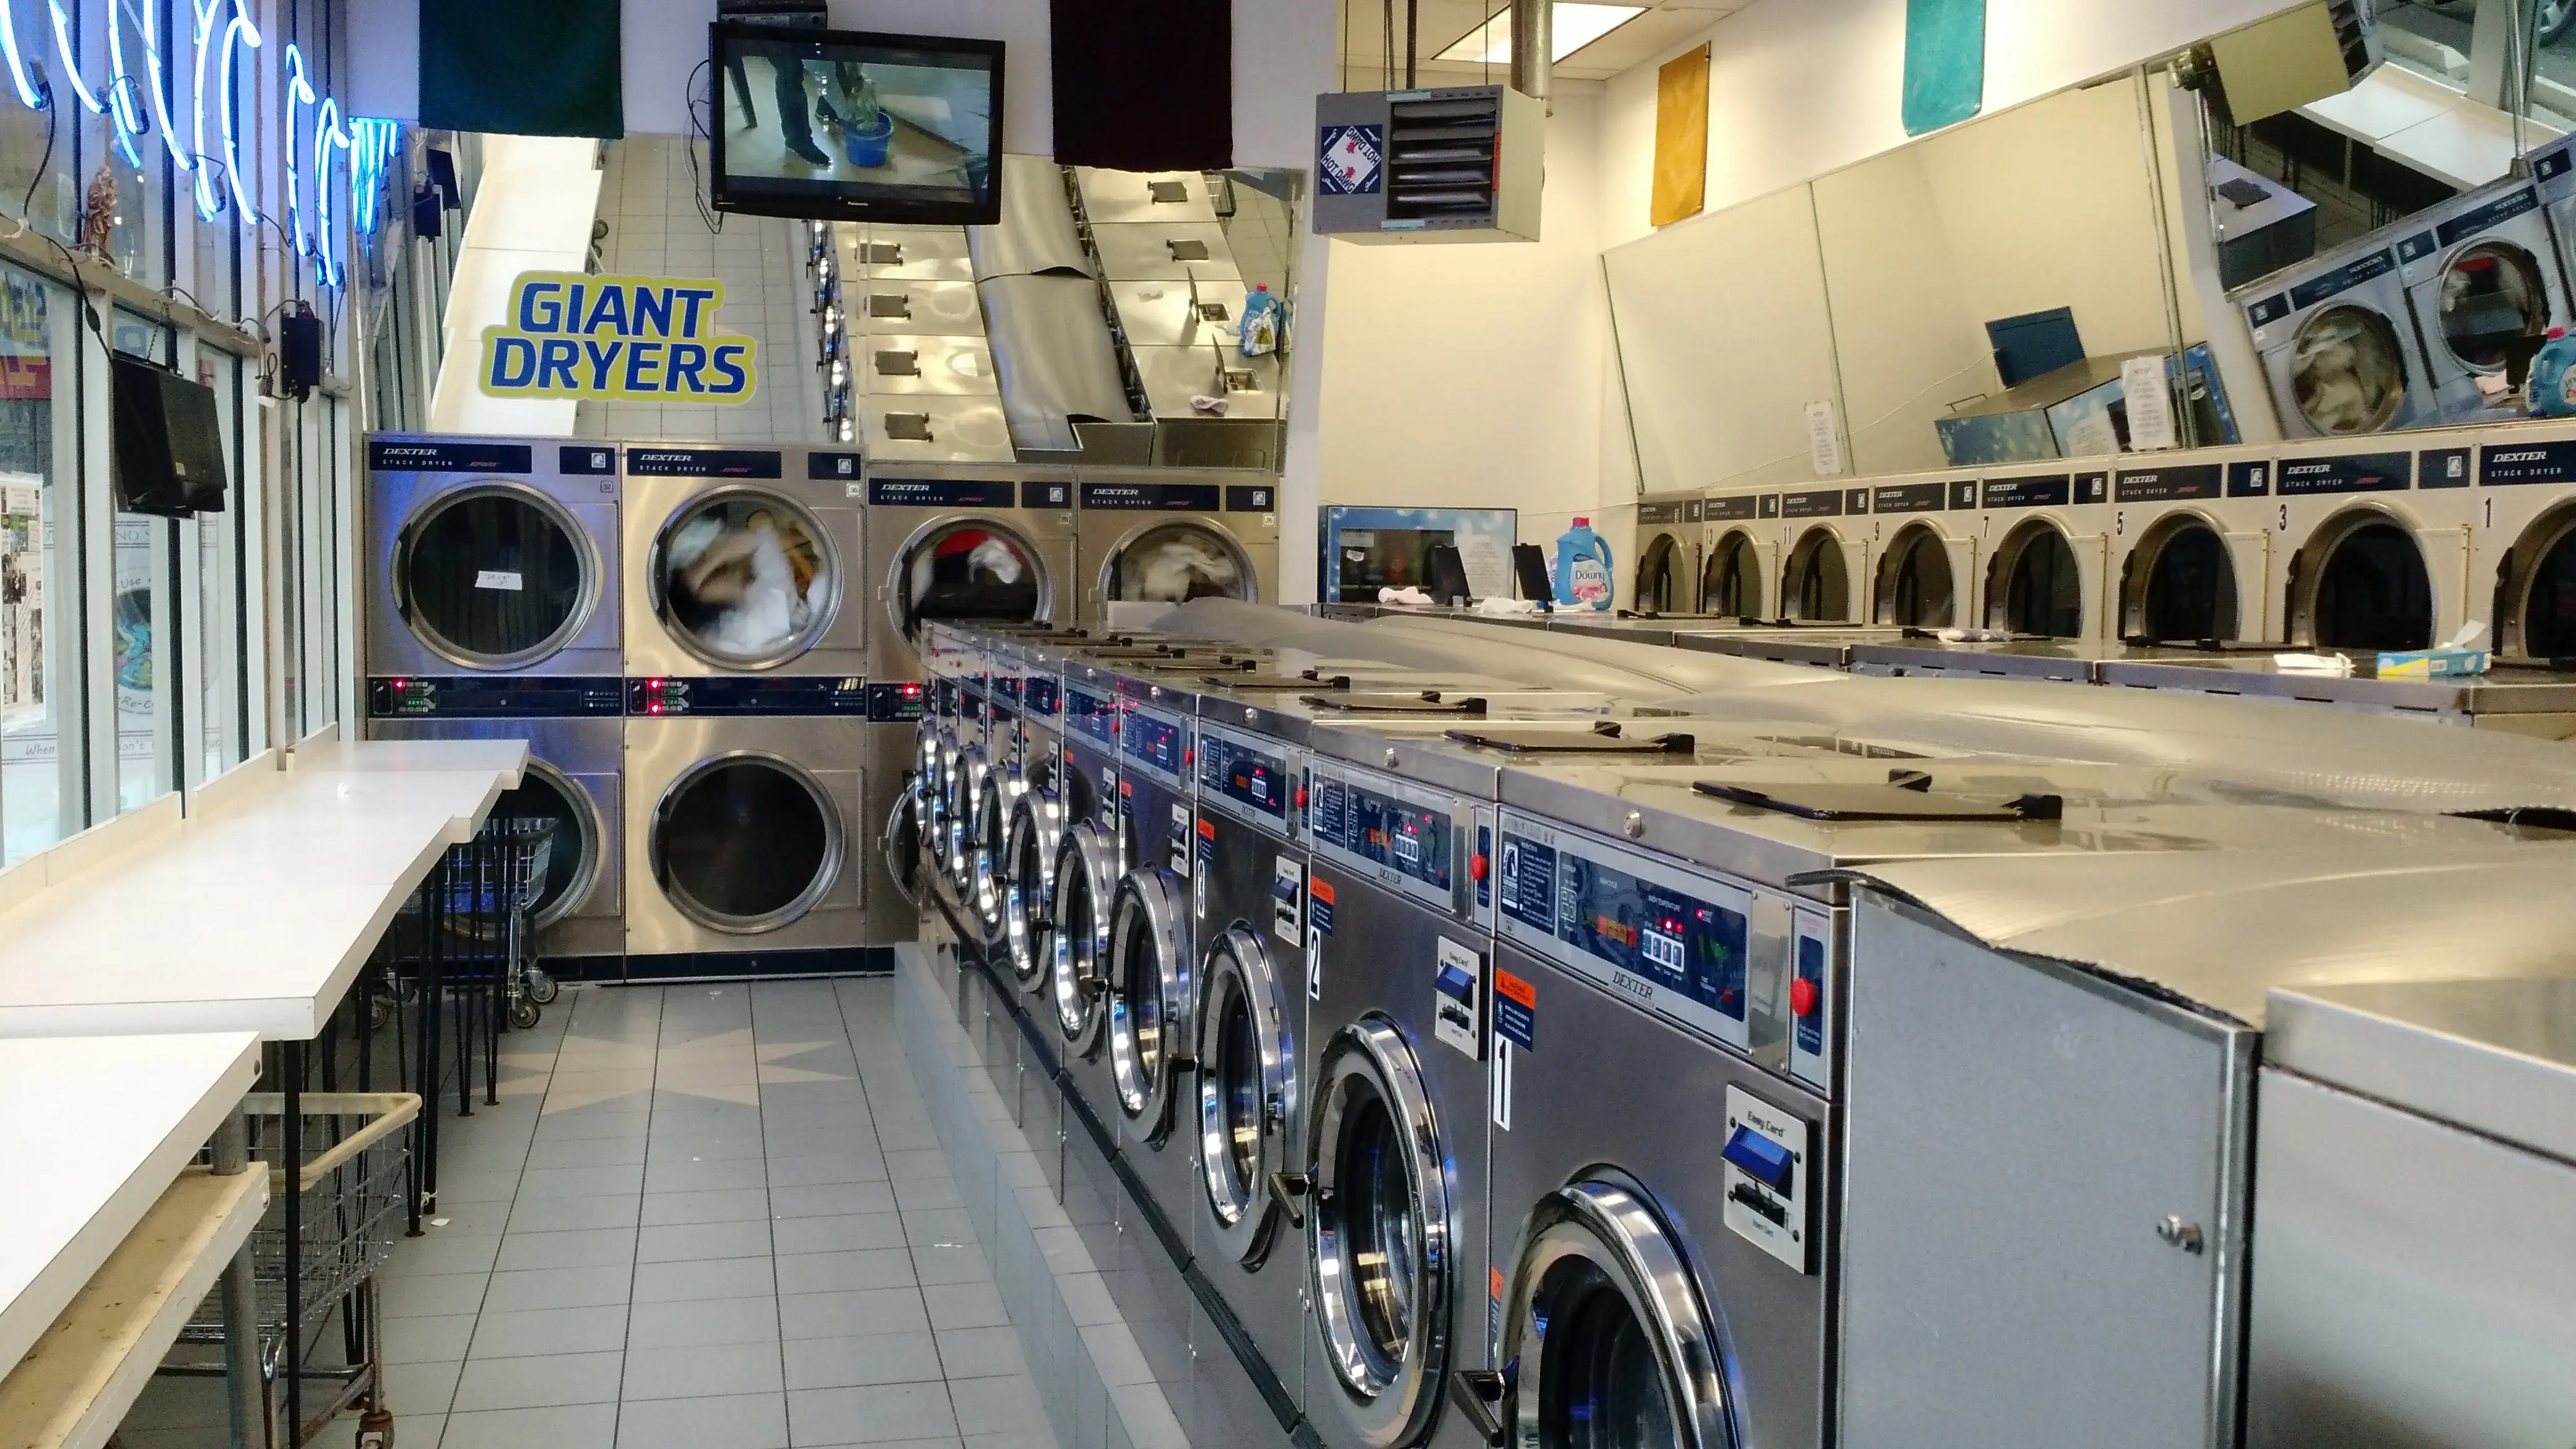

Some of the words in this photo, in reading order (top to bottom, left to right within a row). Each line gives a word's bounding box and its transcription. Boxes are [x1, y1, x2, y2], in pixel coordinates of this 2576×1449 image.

[1346, 128, 1367, 151] DAWG
[1363, 147, 1380, 166] HOT
[1321, 154, 1339, 173] HOT
[1335, 170, 1355, 192] DAWG
[520, 282, 714, 339] GIANT
[490, 337, 746, 394] DRYERS
[2492, 451, 2547, 463] DEXTER
[2123, 475, 2158, 484] DEXTER
[2286, 464, 2331, 475] DEXTER
[2491, 469, 2522, 477] STACK
[2530, 467, 2562, 476] DRYER
[1988, 484, 2018, 492] DEXTER
[2117, 511, 2123, 536] 5
[2279, 503, 2287, 531] 3
[2485, 497, 2491, 528] 1
[1783, 526, 1792, 545] 11
[1874, 521, 1880, 541] 9
[1983, 516, 1989, 538] 7
[1575, 570, 1604, 581] Downy
[25, 744, 55, 755] When
[1378, 868, 1401, 886] DEXTER
[1311, 929, 1318, 996] 2
[1612, 970, 1653, 1000] DEXTER
[1499, 1038, 1507, 1123] 1
[1747, 1110, 1765, 1130] Easy
[1765, 1120, 1783, 1138] Card
